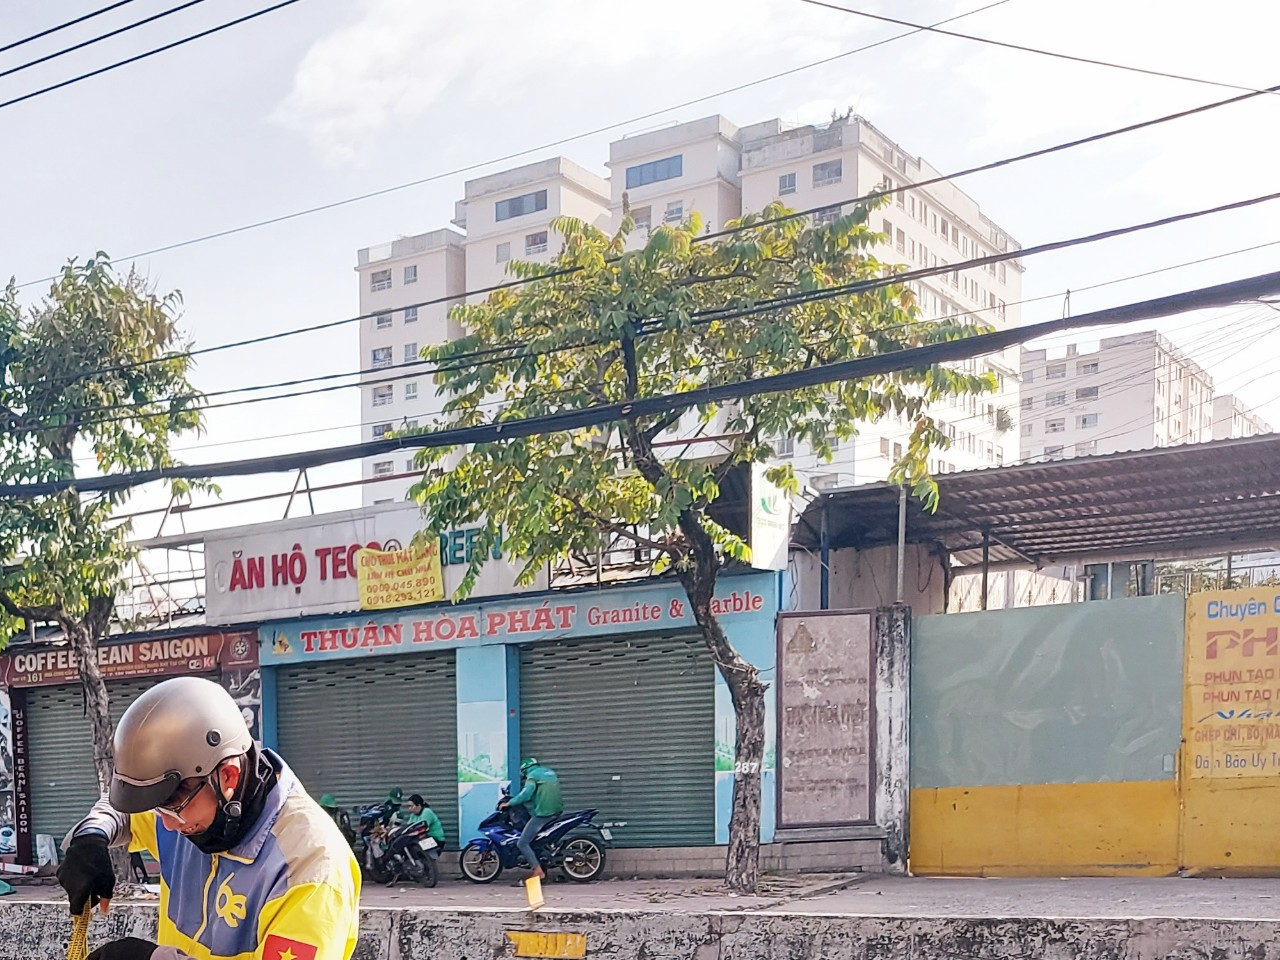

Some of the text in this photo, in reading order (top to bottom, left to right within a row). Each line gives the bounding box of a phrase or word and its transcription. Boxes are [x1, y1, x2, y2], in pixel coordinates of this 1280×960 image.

[271, 543, 307, 593] HỘ
[1207, 596, 1267, 622] Chuyên
[300, 590, 763, 653] THUẬN HÒA PHÁT Granite & arble
[14, 637, 209, 673] COFFEE EAN SAIGON
[27, 673, 43, 682] 161
[1204, 670, 1242, 683] PHUN
[1203, 690, 1240, 703] PHUN
[735, 761, 759, 774] 287
[1252, 753, 1267, 771] Uy
[18, 792, 28, 833] SAIGON
